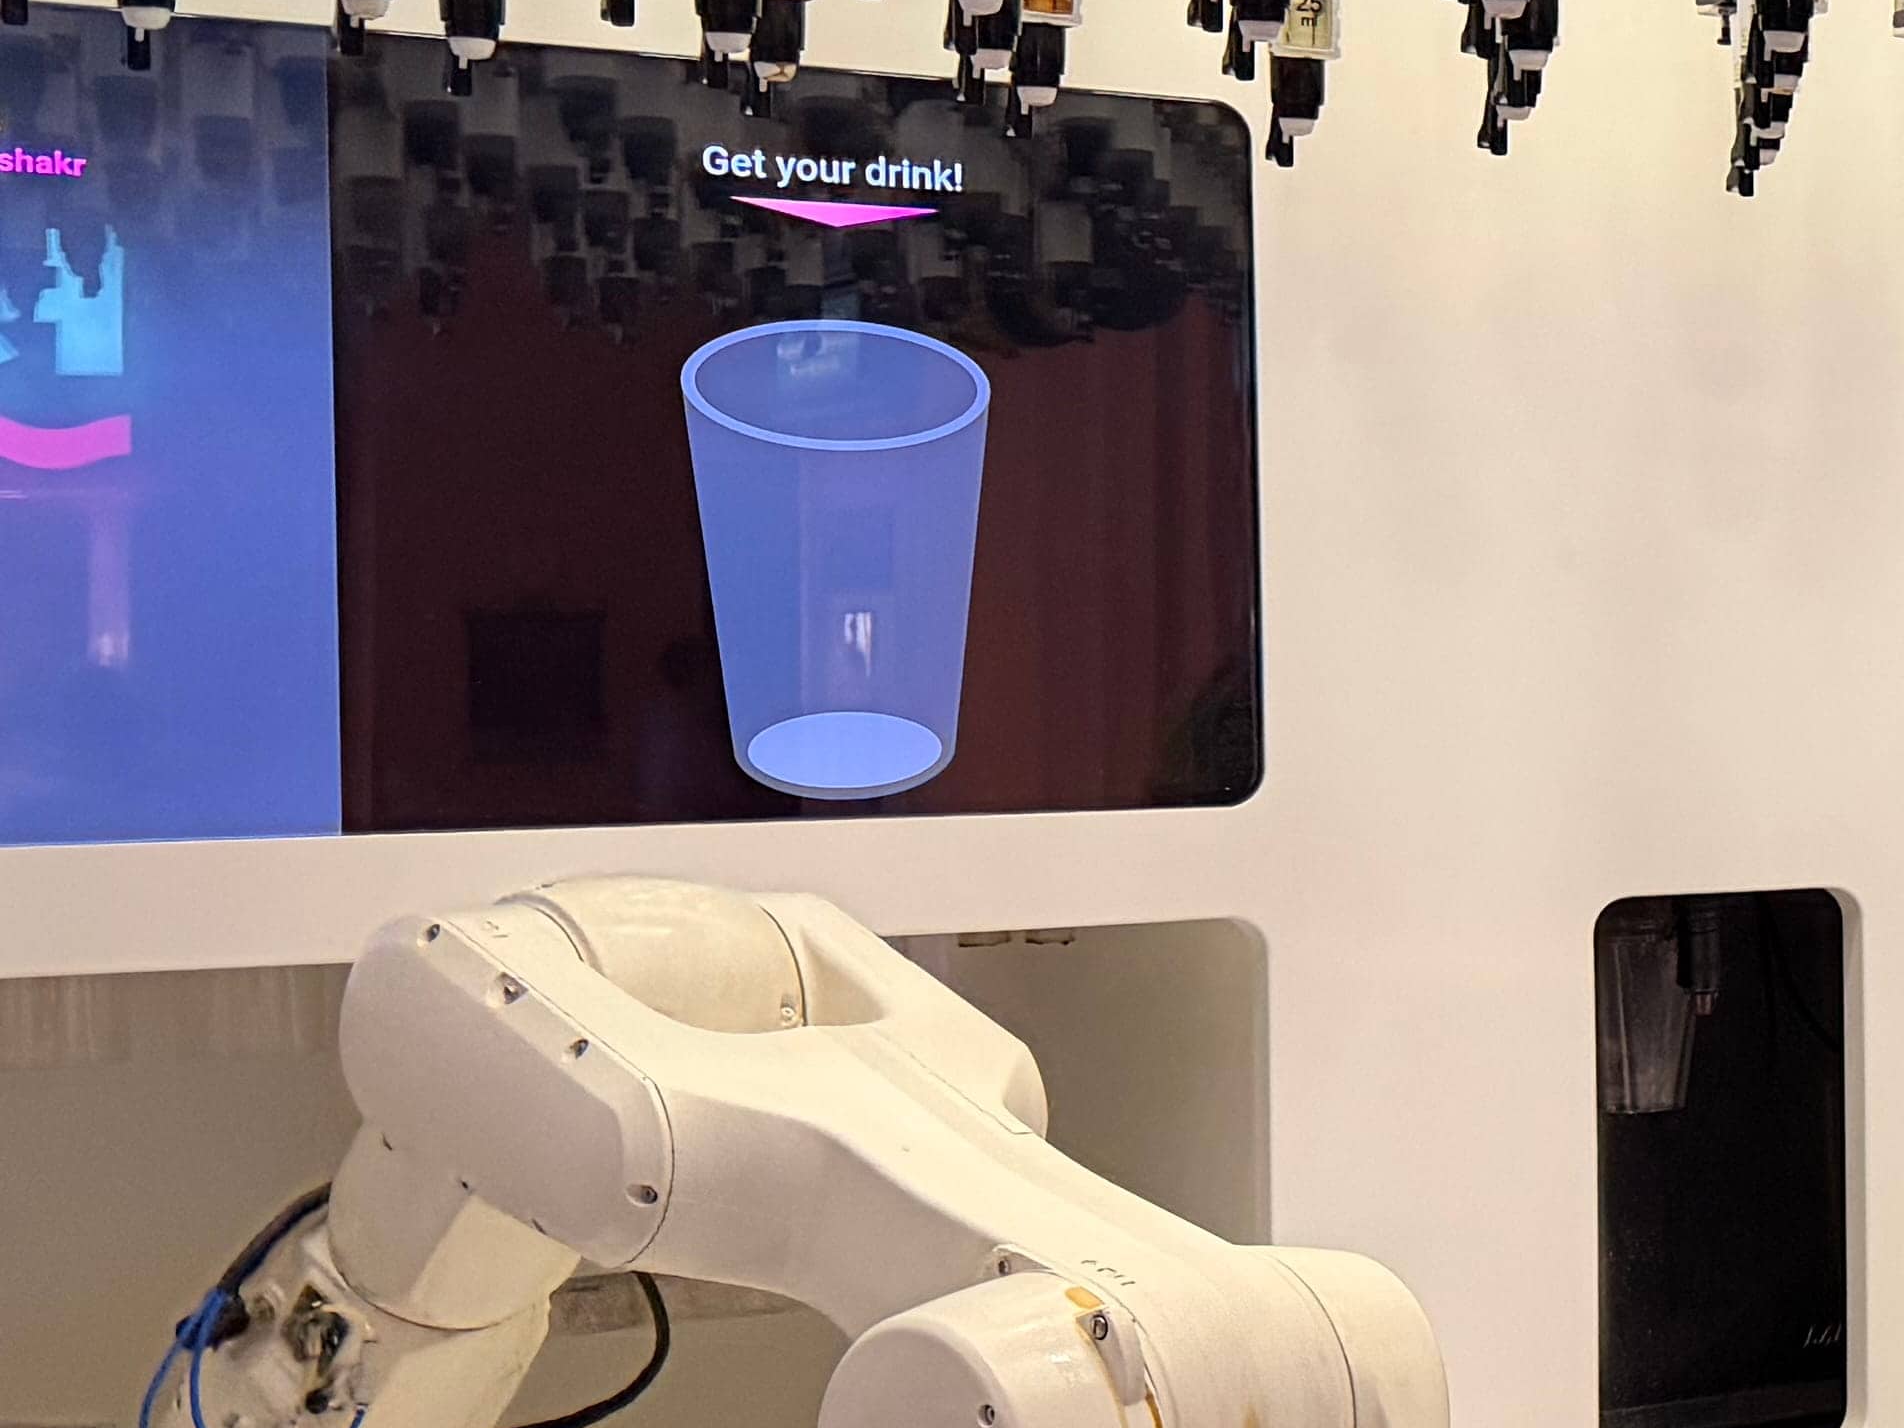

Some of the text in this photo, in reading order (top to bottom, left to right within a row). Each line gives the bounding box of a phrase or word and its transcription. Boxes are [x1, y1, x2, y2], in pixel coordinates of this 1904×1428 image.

[702, 145, 963, 193] Get your drink!
